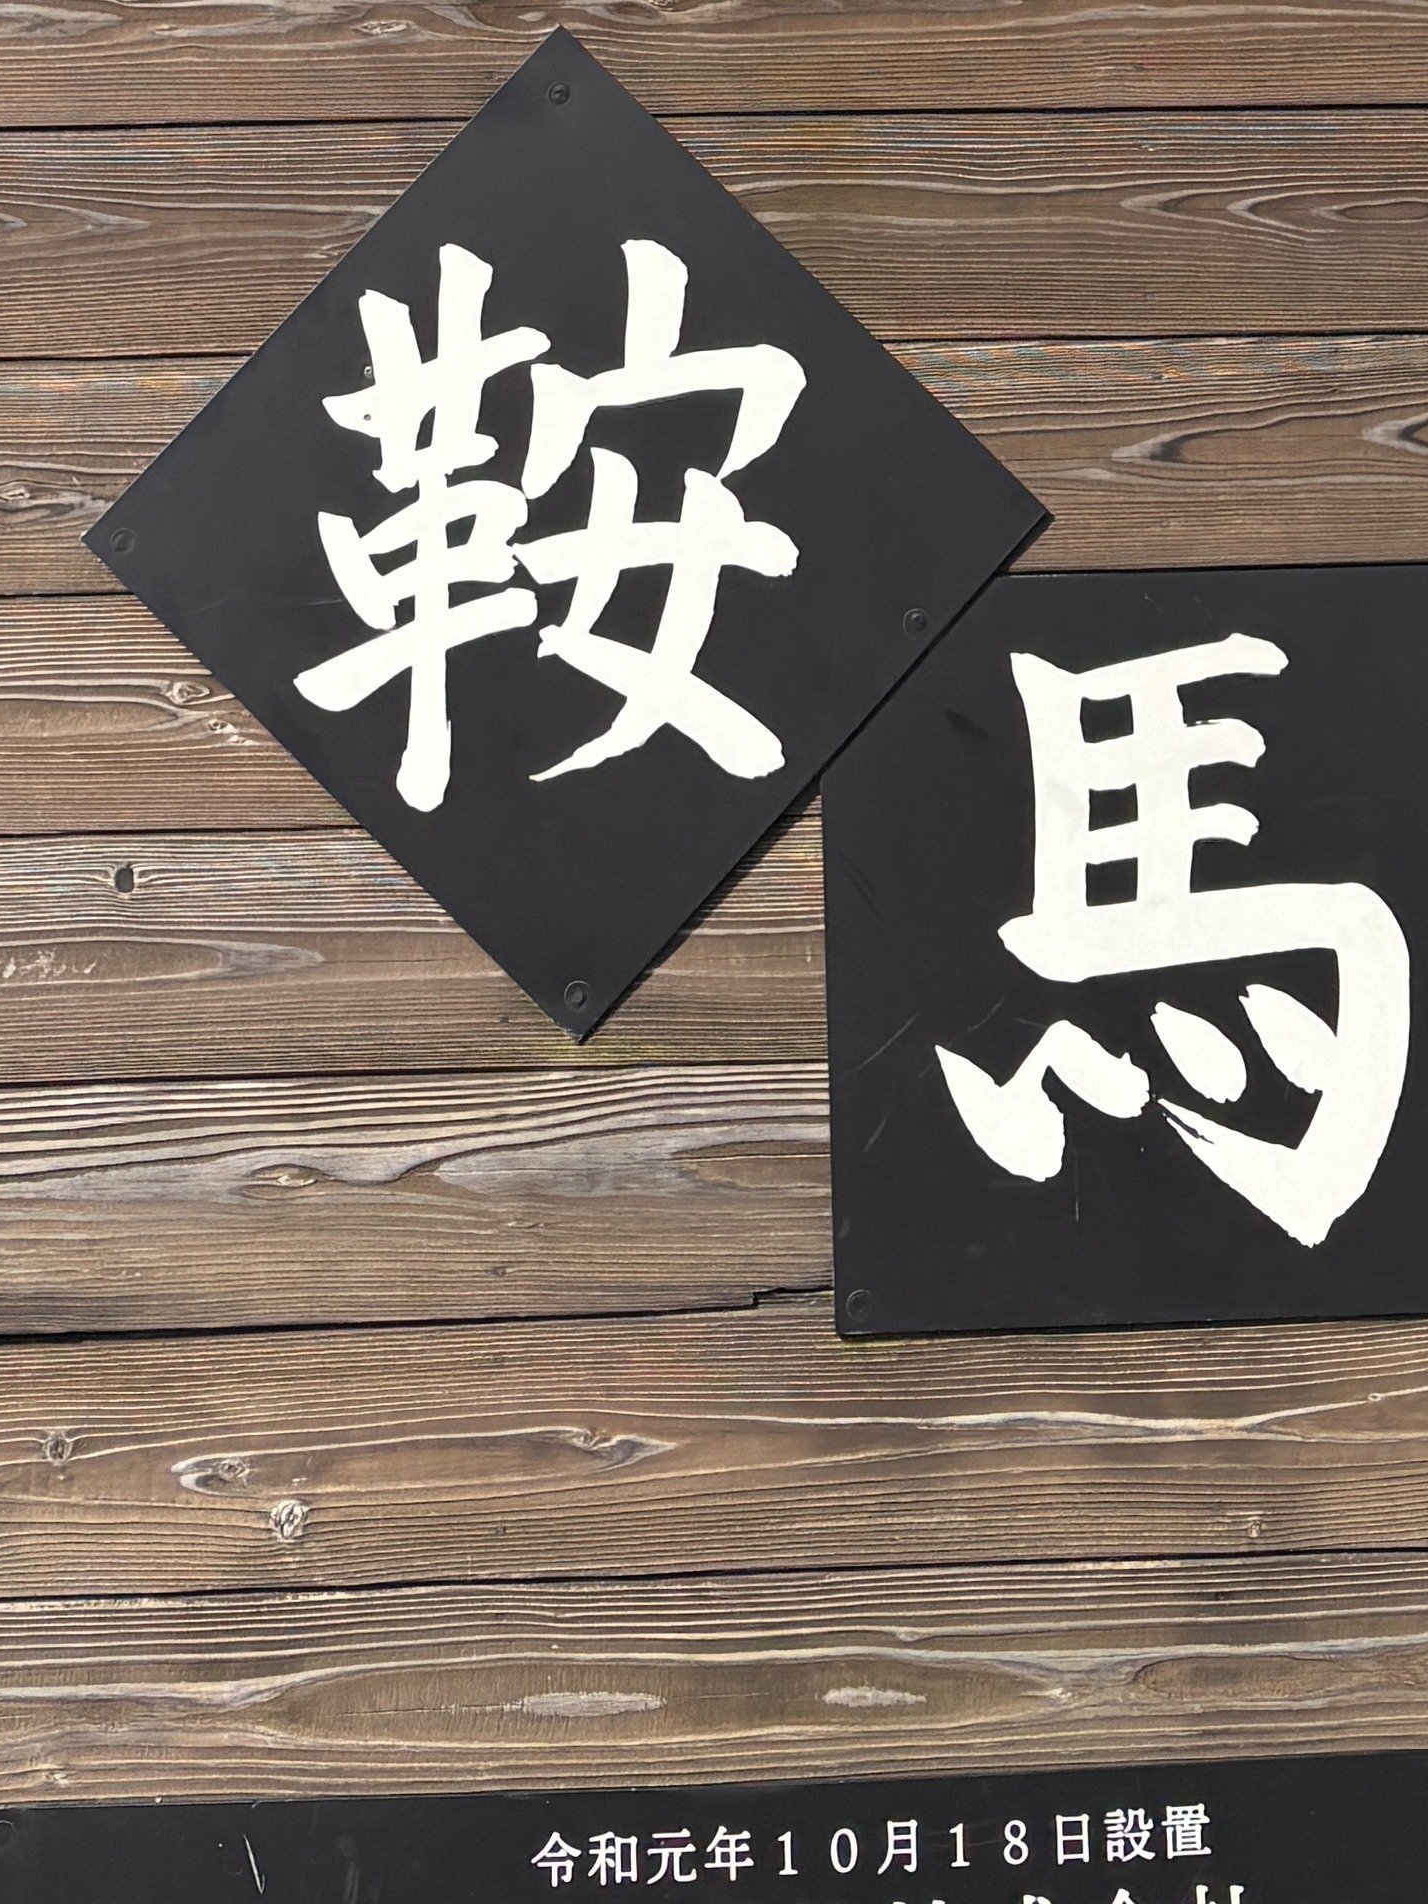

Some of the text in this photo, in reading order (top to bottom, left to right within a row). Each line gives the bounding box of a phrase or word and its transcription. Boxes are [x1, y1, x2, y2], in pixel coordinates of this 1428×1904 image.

[293, 238, 1411, 1247] 鞍 馬
[530, 1803, 1213, 1887] 令和元年10月18日設置
